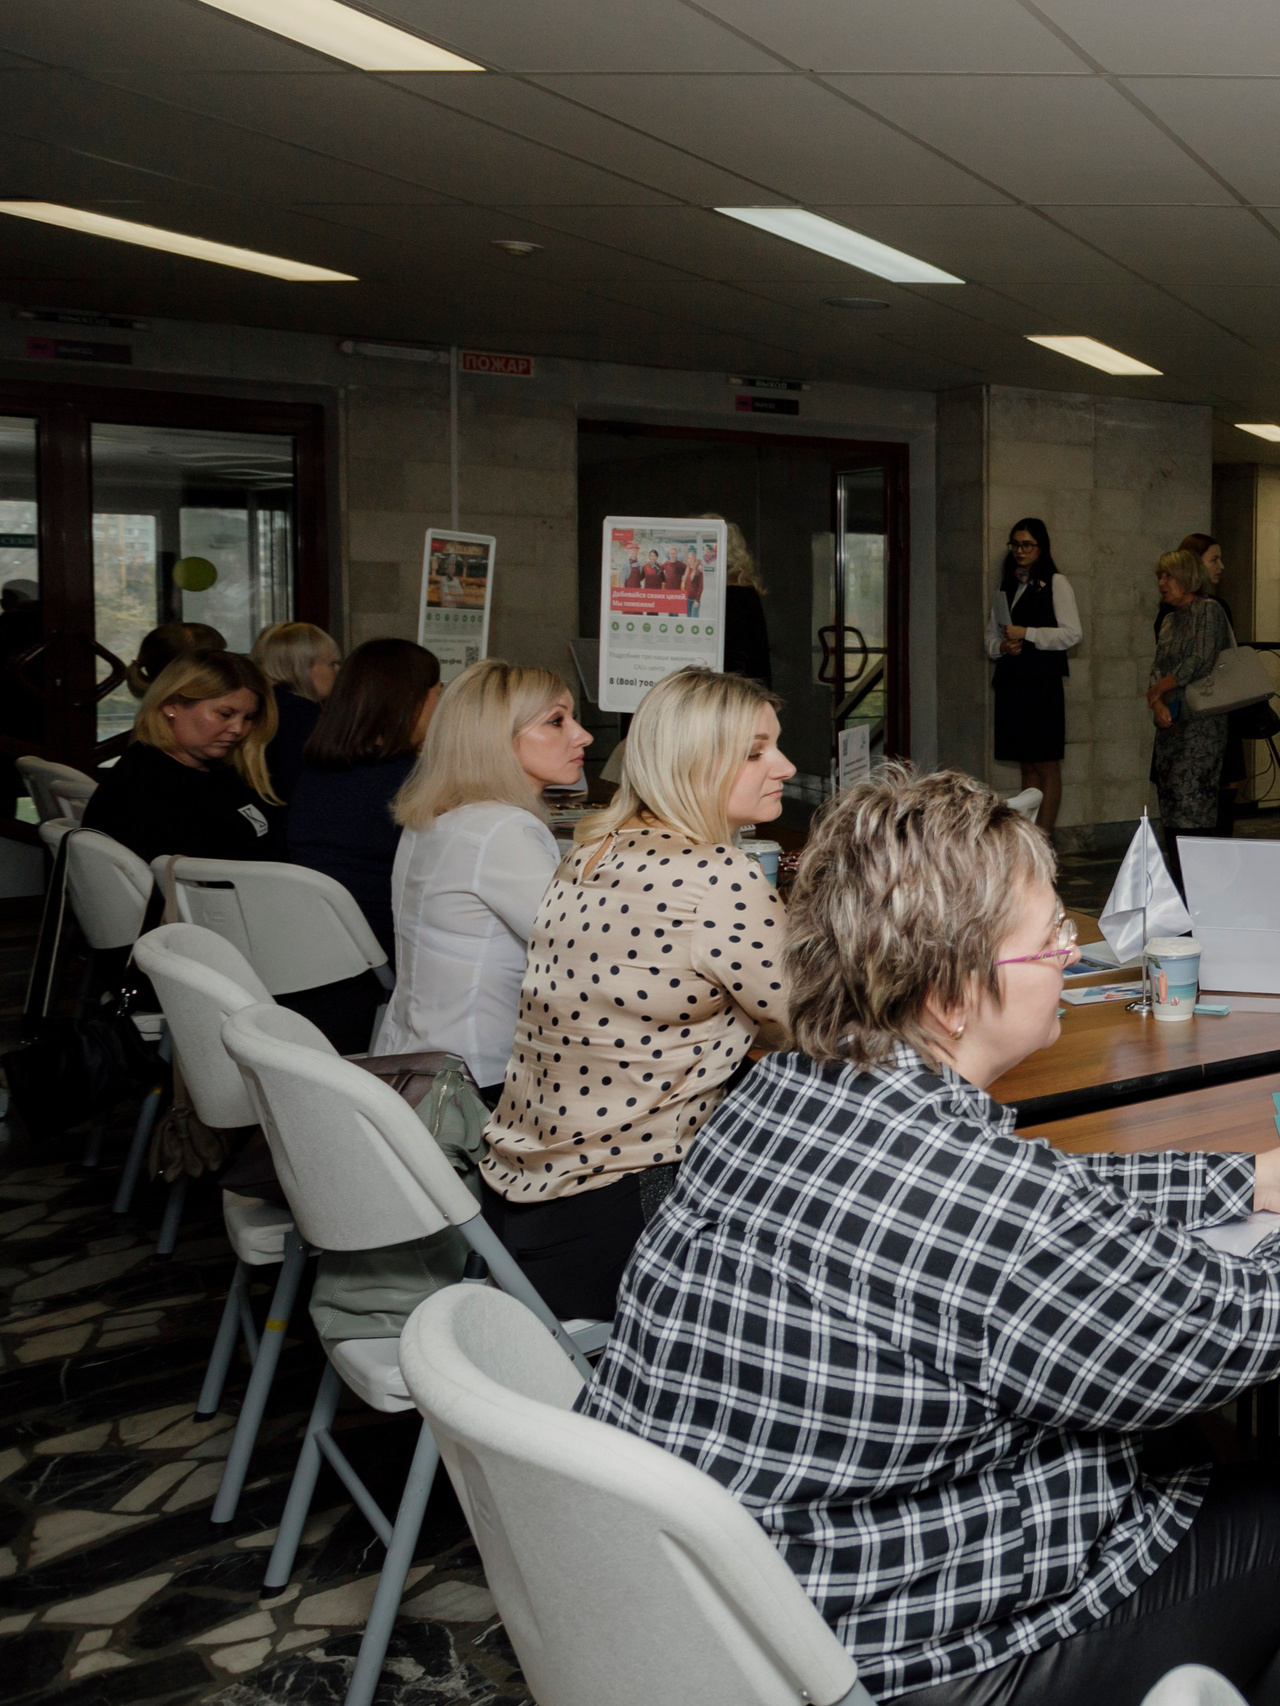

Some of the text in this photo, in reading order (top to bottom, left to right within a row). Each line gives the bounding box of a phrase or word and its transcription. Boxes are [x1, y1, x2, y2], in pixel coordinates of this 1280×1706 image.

[465, 355, 528, 373] ПОЖАР
[612, 590, 647, 599] Добивайся
[609, 652, 640, 660] Подробнее
[609, 677, 615, 685] 8
[616, 677, 638, 687] (800)
